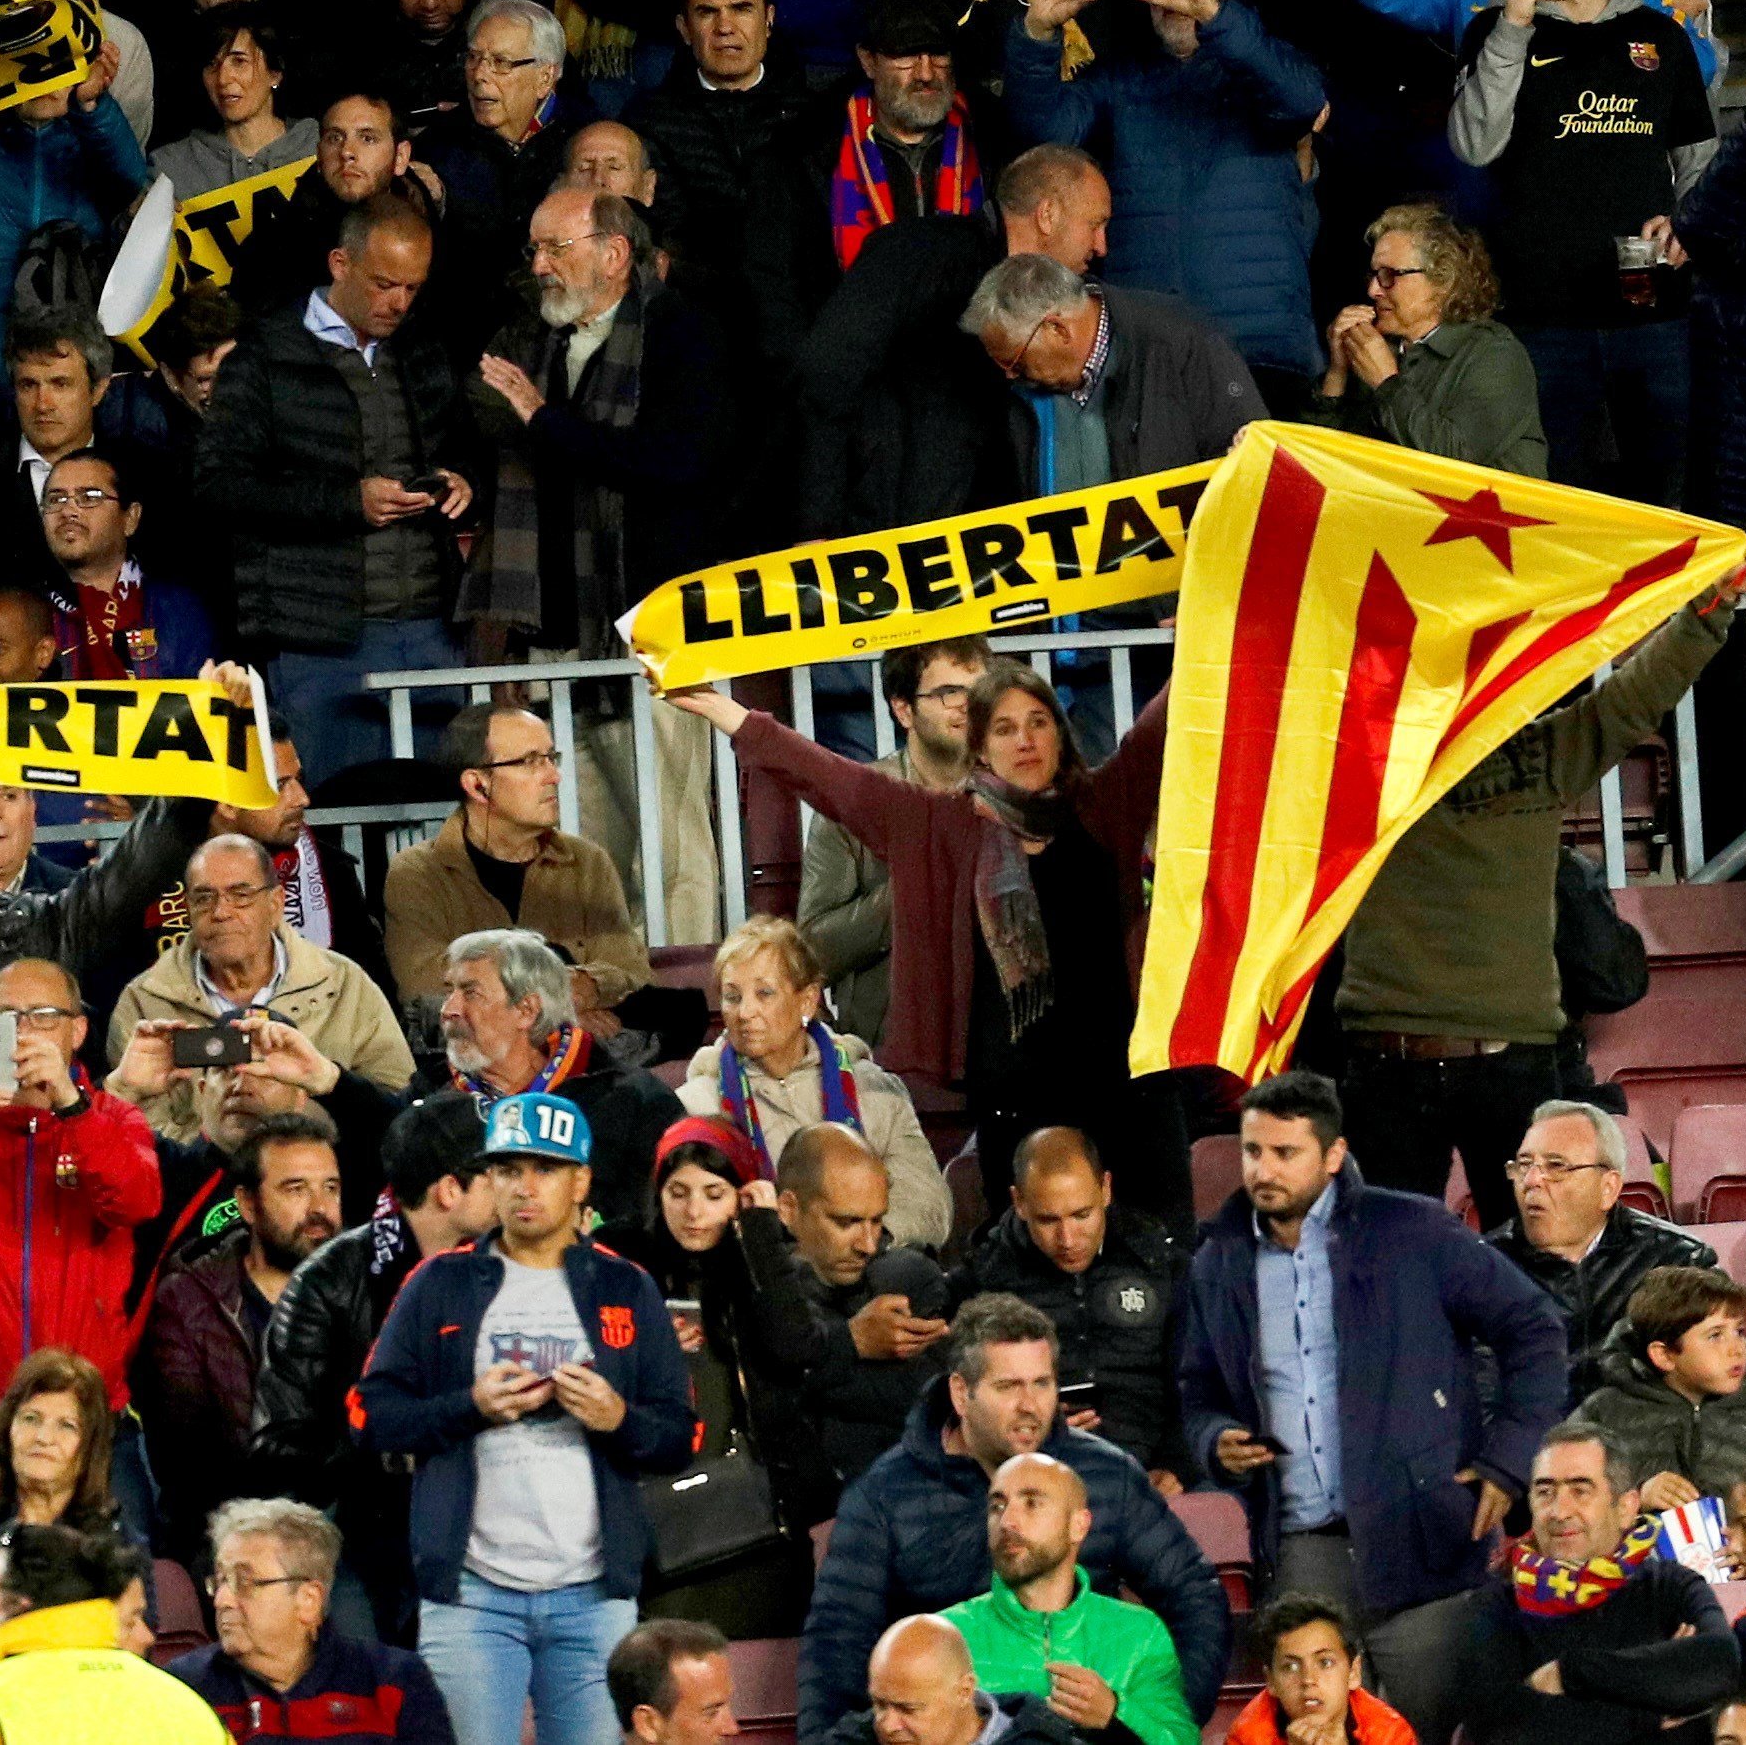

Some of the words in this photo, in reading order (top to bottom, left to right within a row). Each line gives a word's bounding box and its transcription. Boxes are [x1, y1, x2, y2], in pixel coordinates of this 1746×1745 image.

[1578, 90, 1638, 120] Qatar
[1554, 112, 1653, 139] Foundation
[535, 1105, 575, 1147] 10
